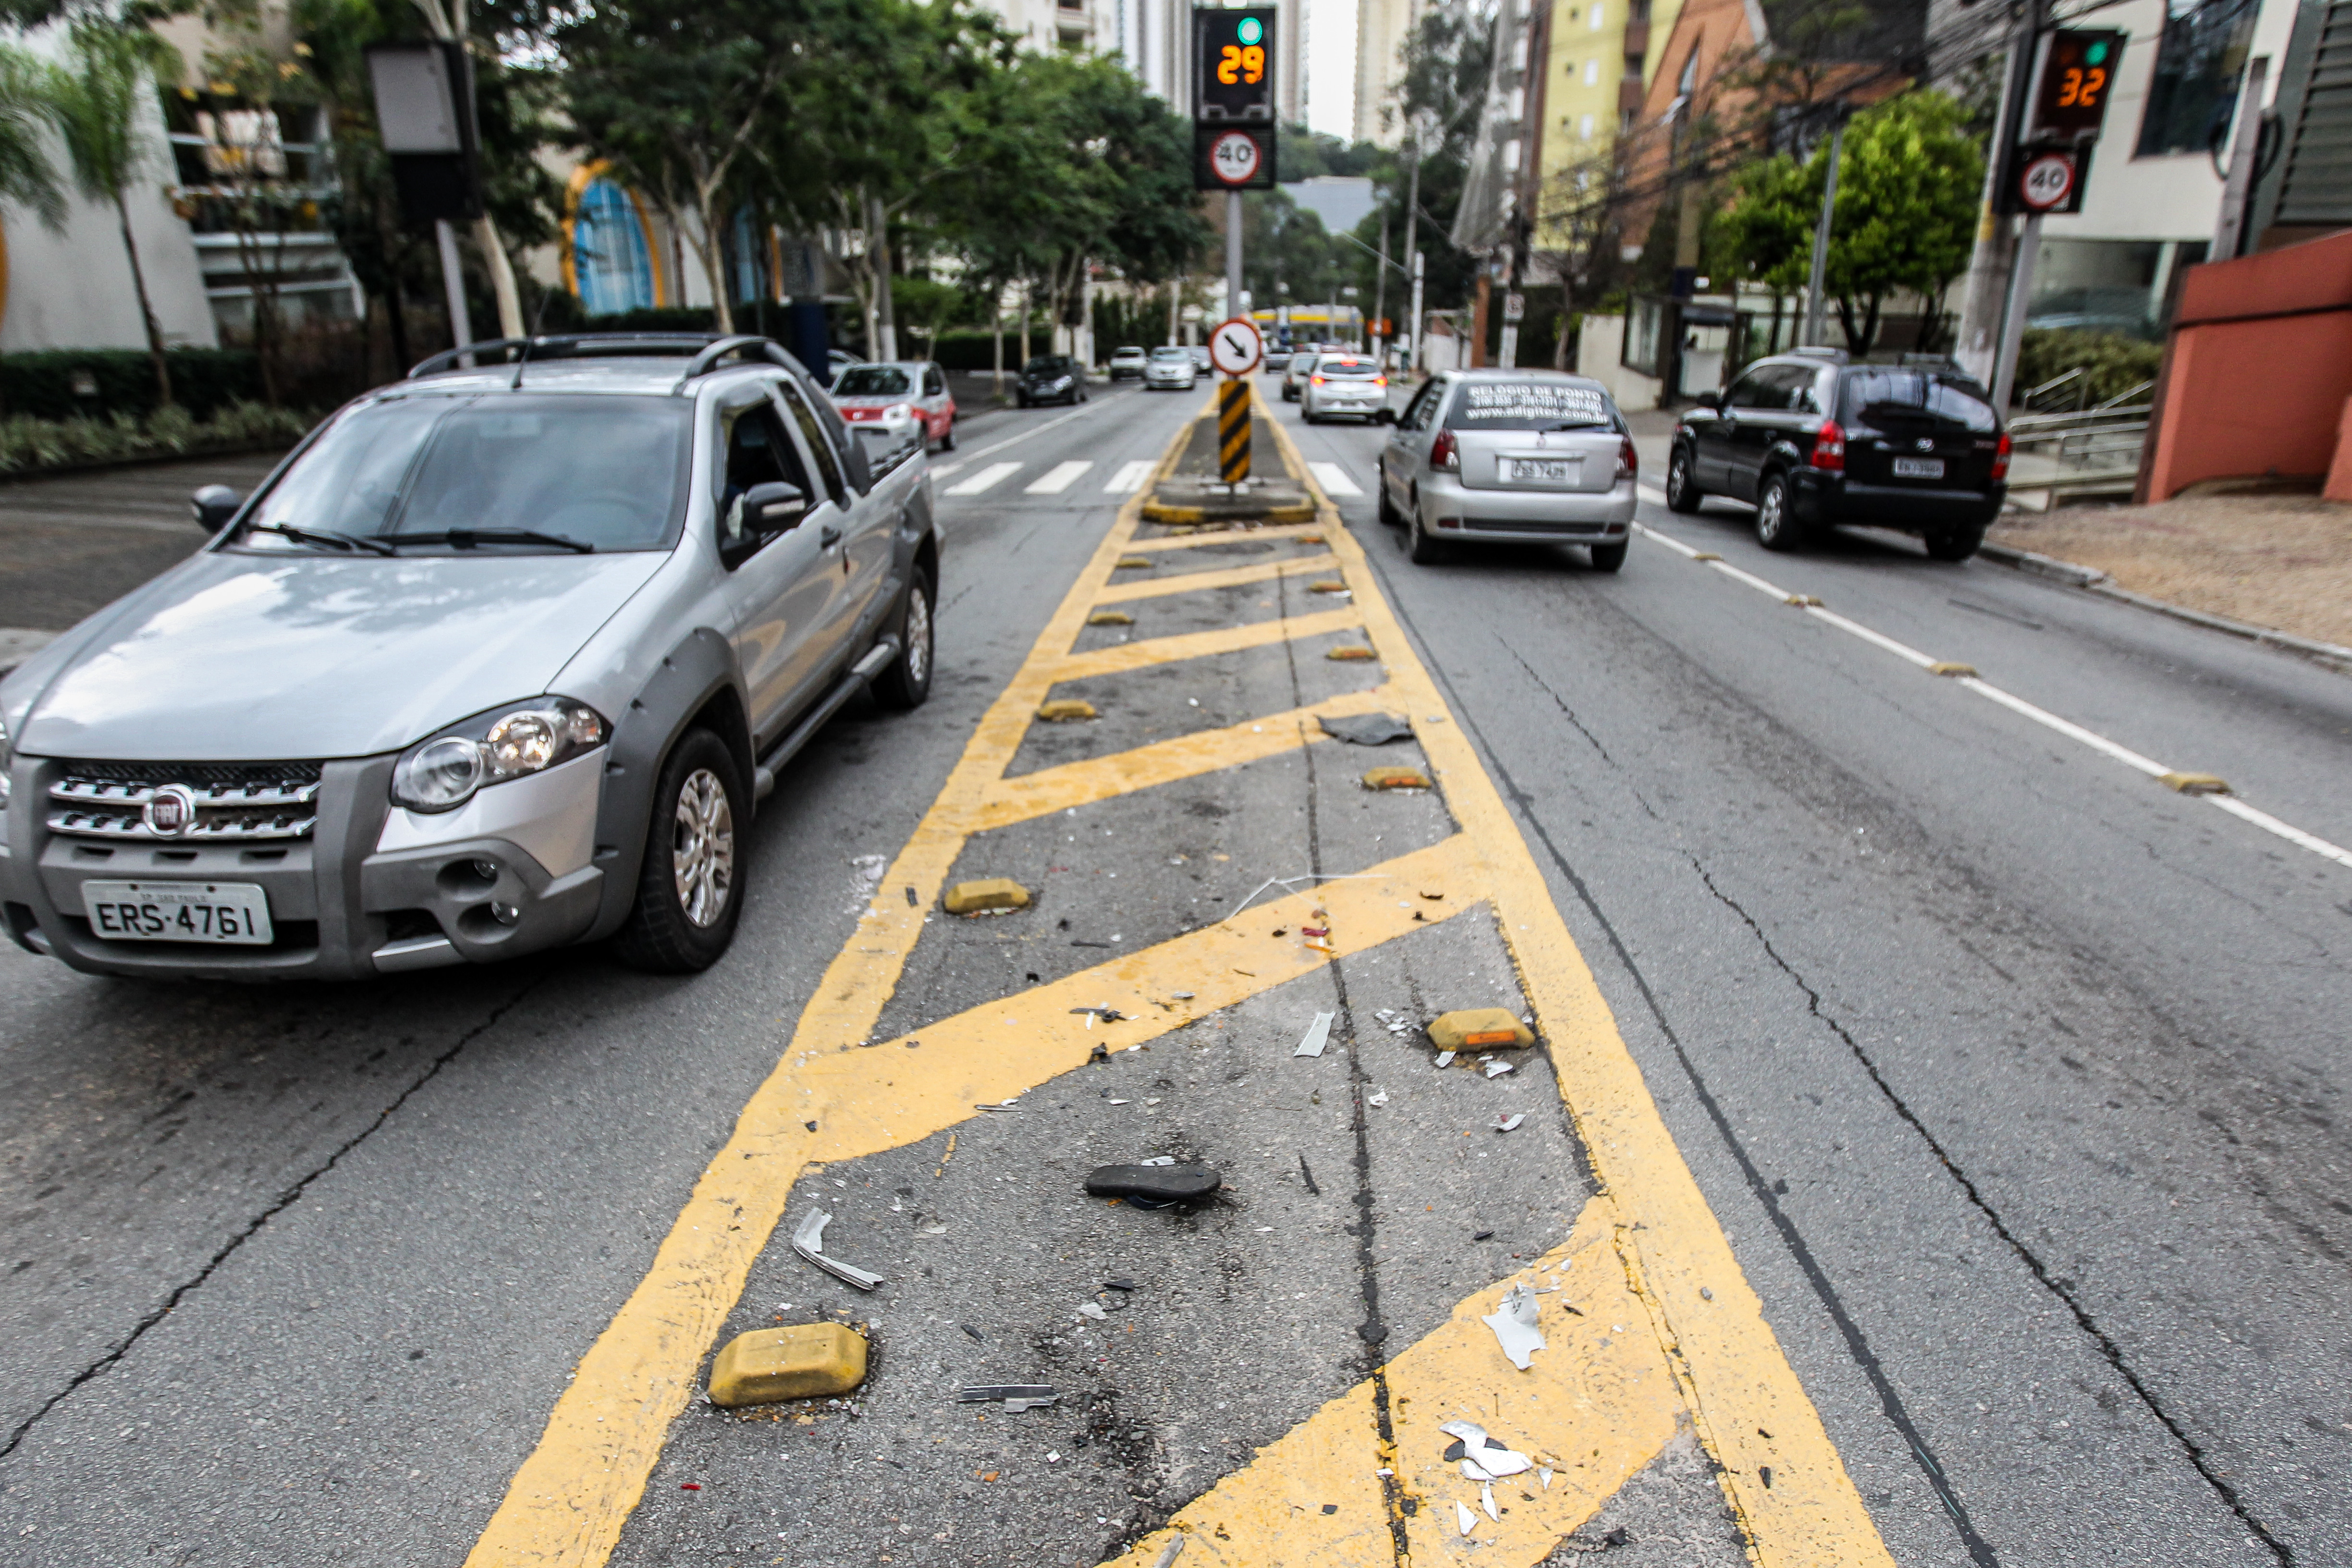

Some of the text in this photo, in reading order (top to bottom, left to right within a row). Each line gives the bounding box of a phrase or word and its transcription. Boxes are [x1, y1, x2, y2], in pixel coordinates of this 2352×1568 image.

[1217, 45, 1264, 84] 29
[2057, 67, 2107, 107] 32
[1217, 144, 1252, 162] 40
[2031, 168, 2066, 187] 40
